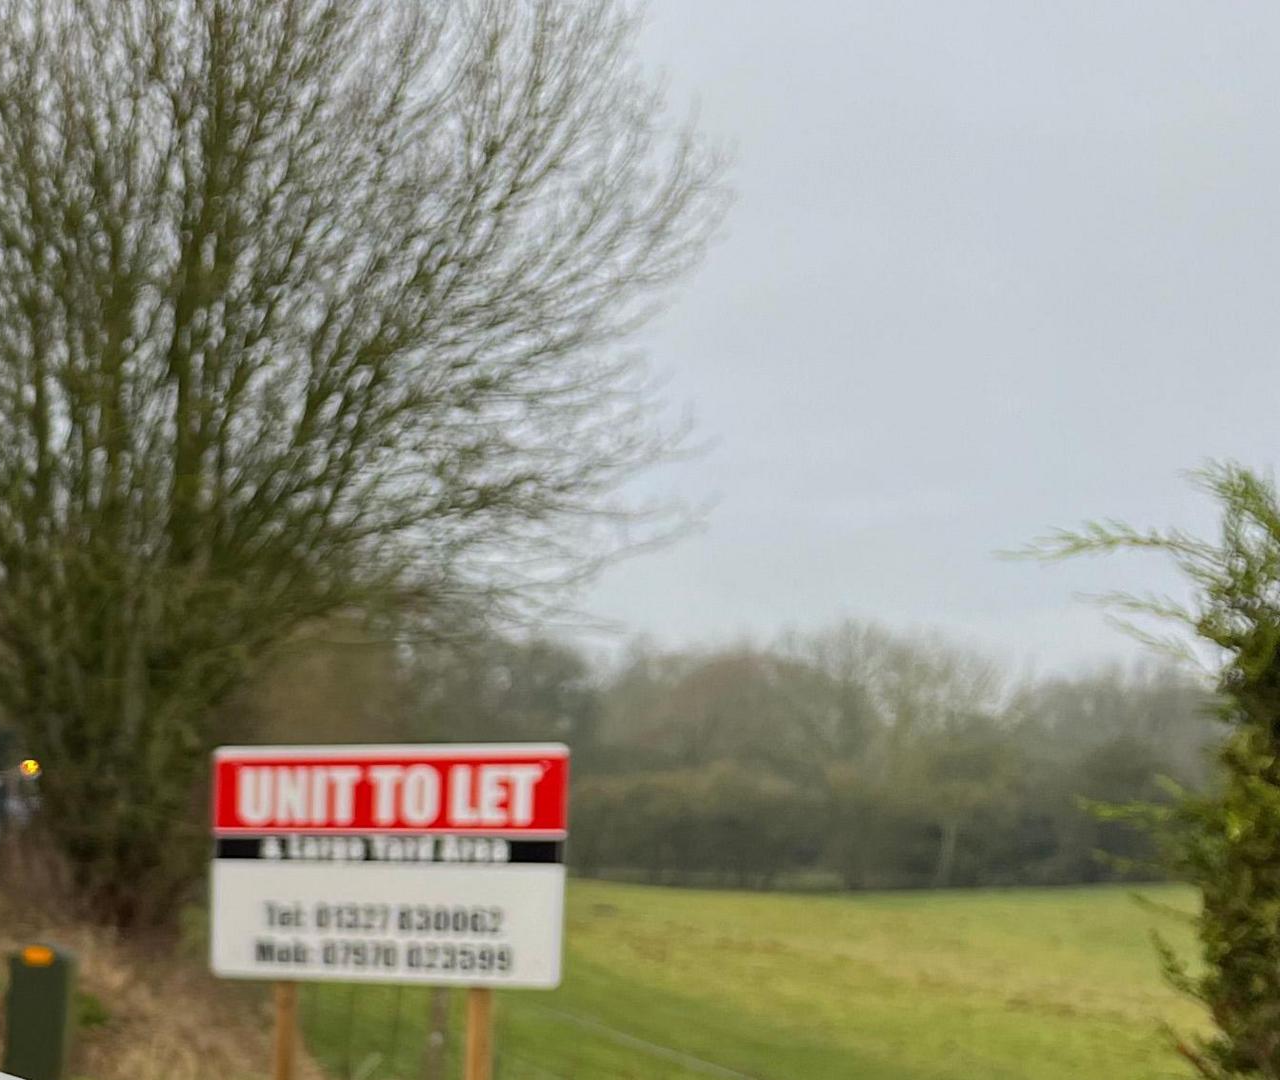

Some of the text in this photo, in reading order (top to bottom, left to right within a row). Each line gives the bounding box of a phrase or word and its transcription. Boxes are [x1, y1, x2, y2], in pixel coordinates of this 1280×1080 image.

[240, 763, 543, 827] UNIT TO LET
